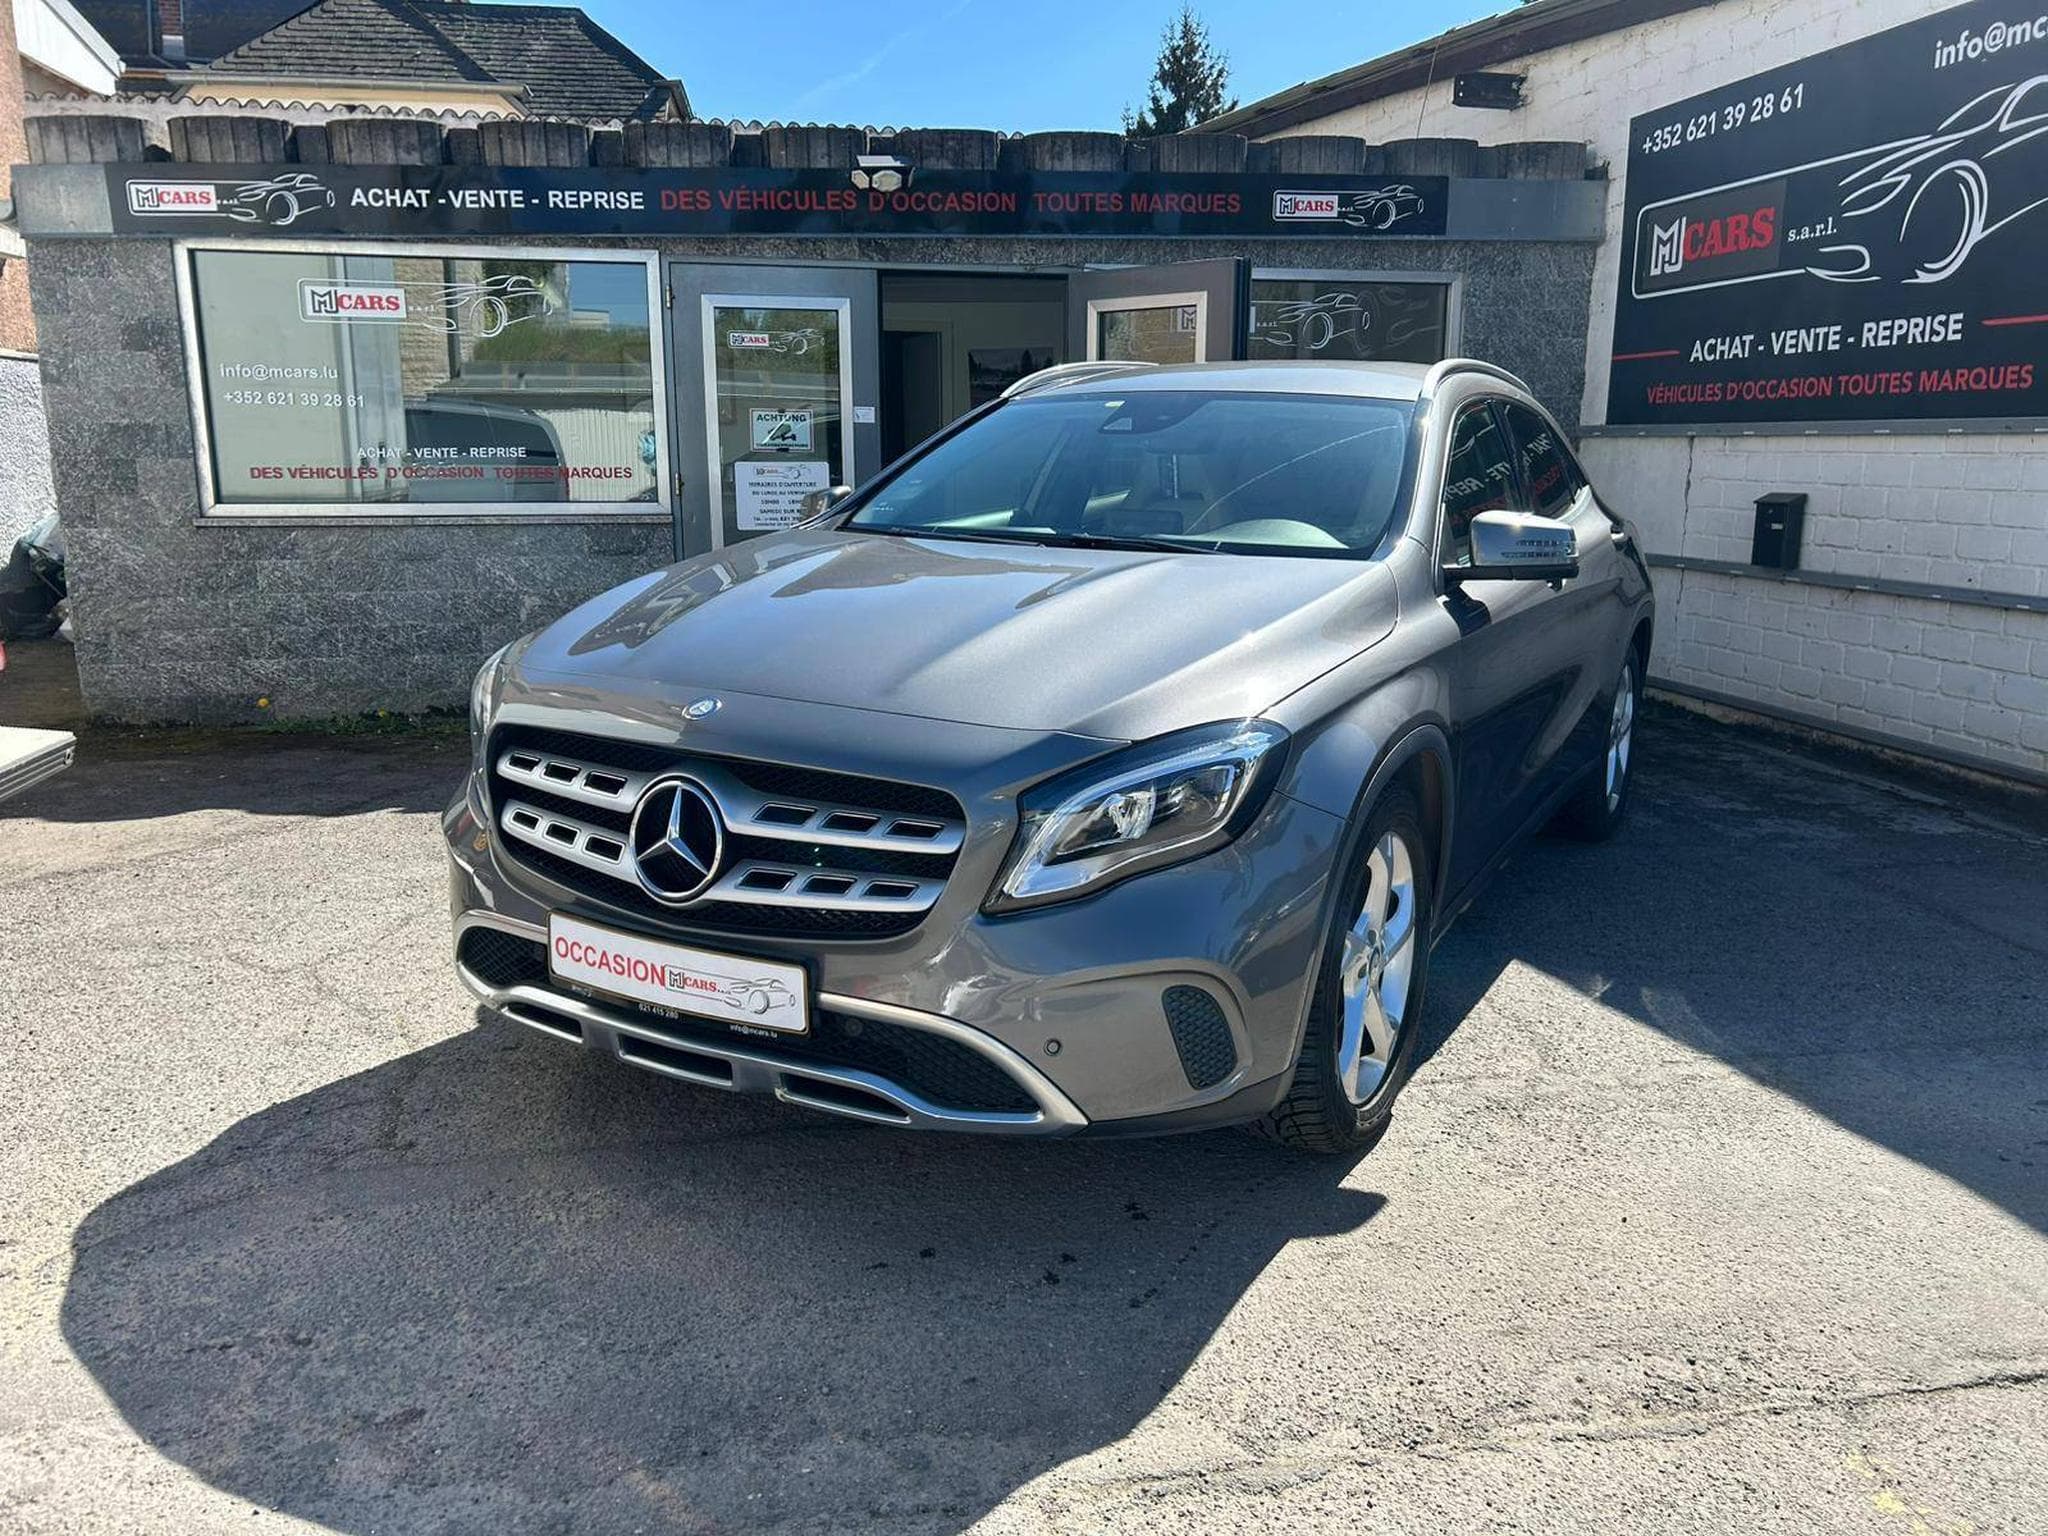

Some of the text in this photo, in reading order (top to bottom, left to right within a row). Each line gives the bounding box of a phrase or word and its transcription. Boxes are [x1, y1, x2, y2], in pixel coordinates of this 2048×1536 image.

[1934, 15, 2048, 69] info@mc
[1643, 82, 1804, 154] +352 621 39 28 61
[350, 188, 431, 208] ACHAT
[547, 190, 645, 210] REPRISE
[660, 190, 712, 211] DES
[718, 186, 858, 211] VÉHICULES
[868, 192, 1016, 213] D'OCCASION
[1033, 192, 1124, 213] TOUTES
[1130, 194, 1241, 214] MARQUES
[1787, 216, 1838, 242] s.a.r.l.
[1689, 334, 1754, 363] ACHAT
[1771, 325, 1842, 355] VENTE
[1861, 313, 1964, 348] REPRISE
[219, 362, 339, 381] info@mcars.lu
[1646, 364, 2034, 405] VÉHICULES D'OCCASION TOUTES MARQUES
[223, 390, 365, 408] +352 621 39 28 61
[756, 413, 807, 423] ACHTUNG
[357, 447, 402, 459] ACHAT
[414, 447, 459, 459] VENTE
[470, 446, 527, 458] REPRISE
[250, 463, 633, 480] DES VÉHICULES D'OCCASION TOUTES MARQUES
[554, 936, 666, 987] OCCASION
